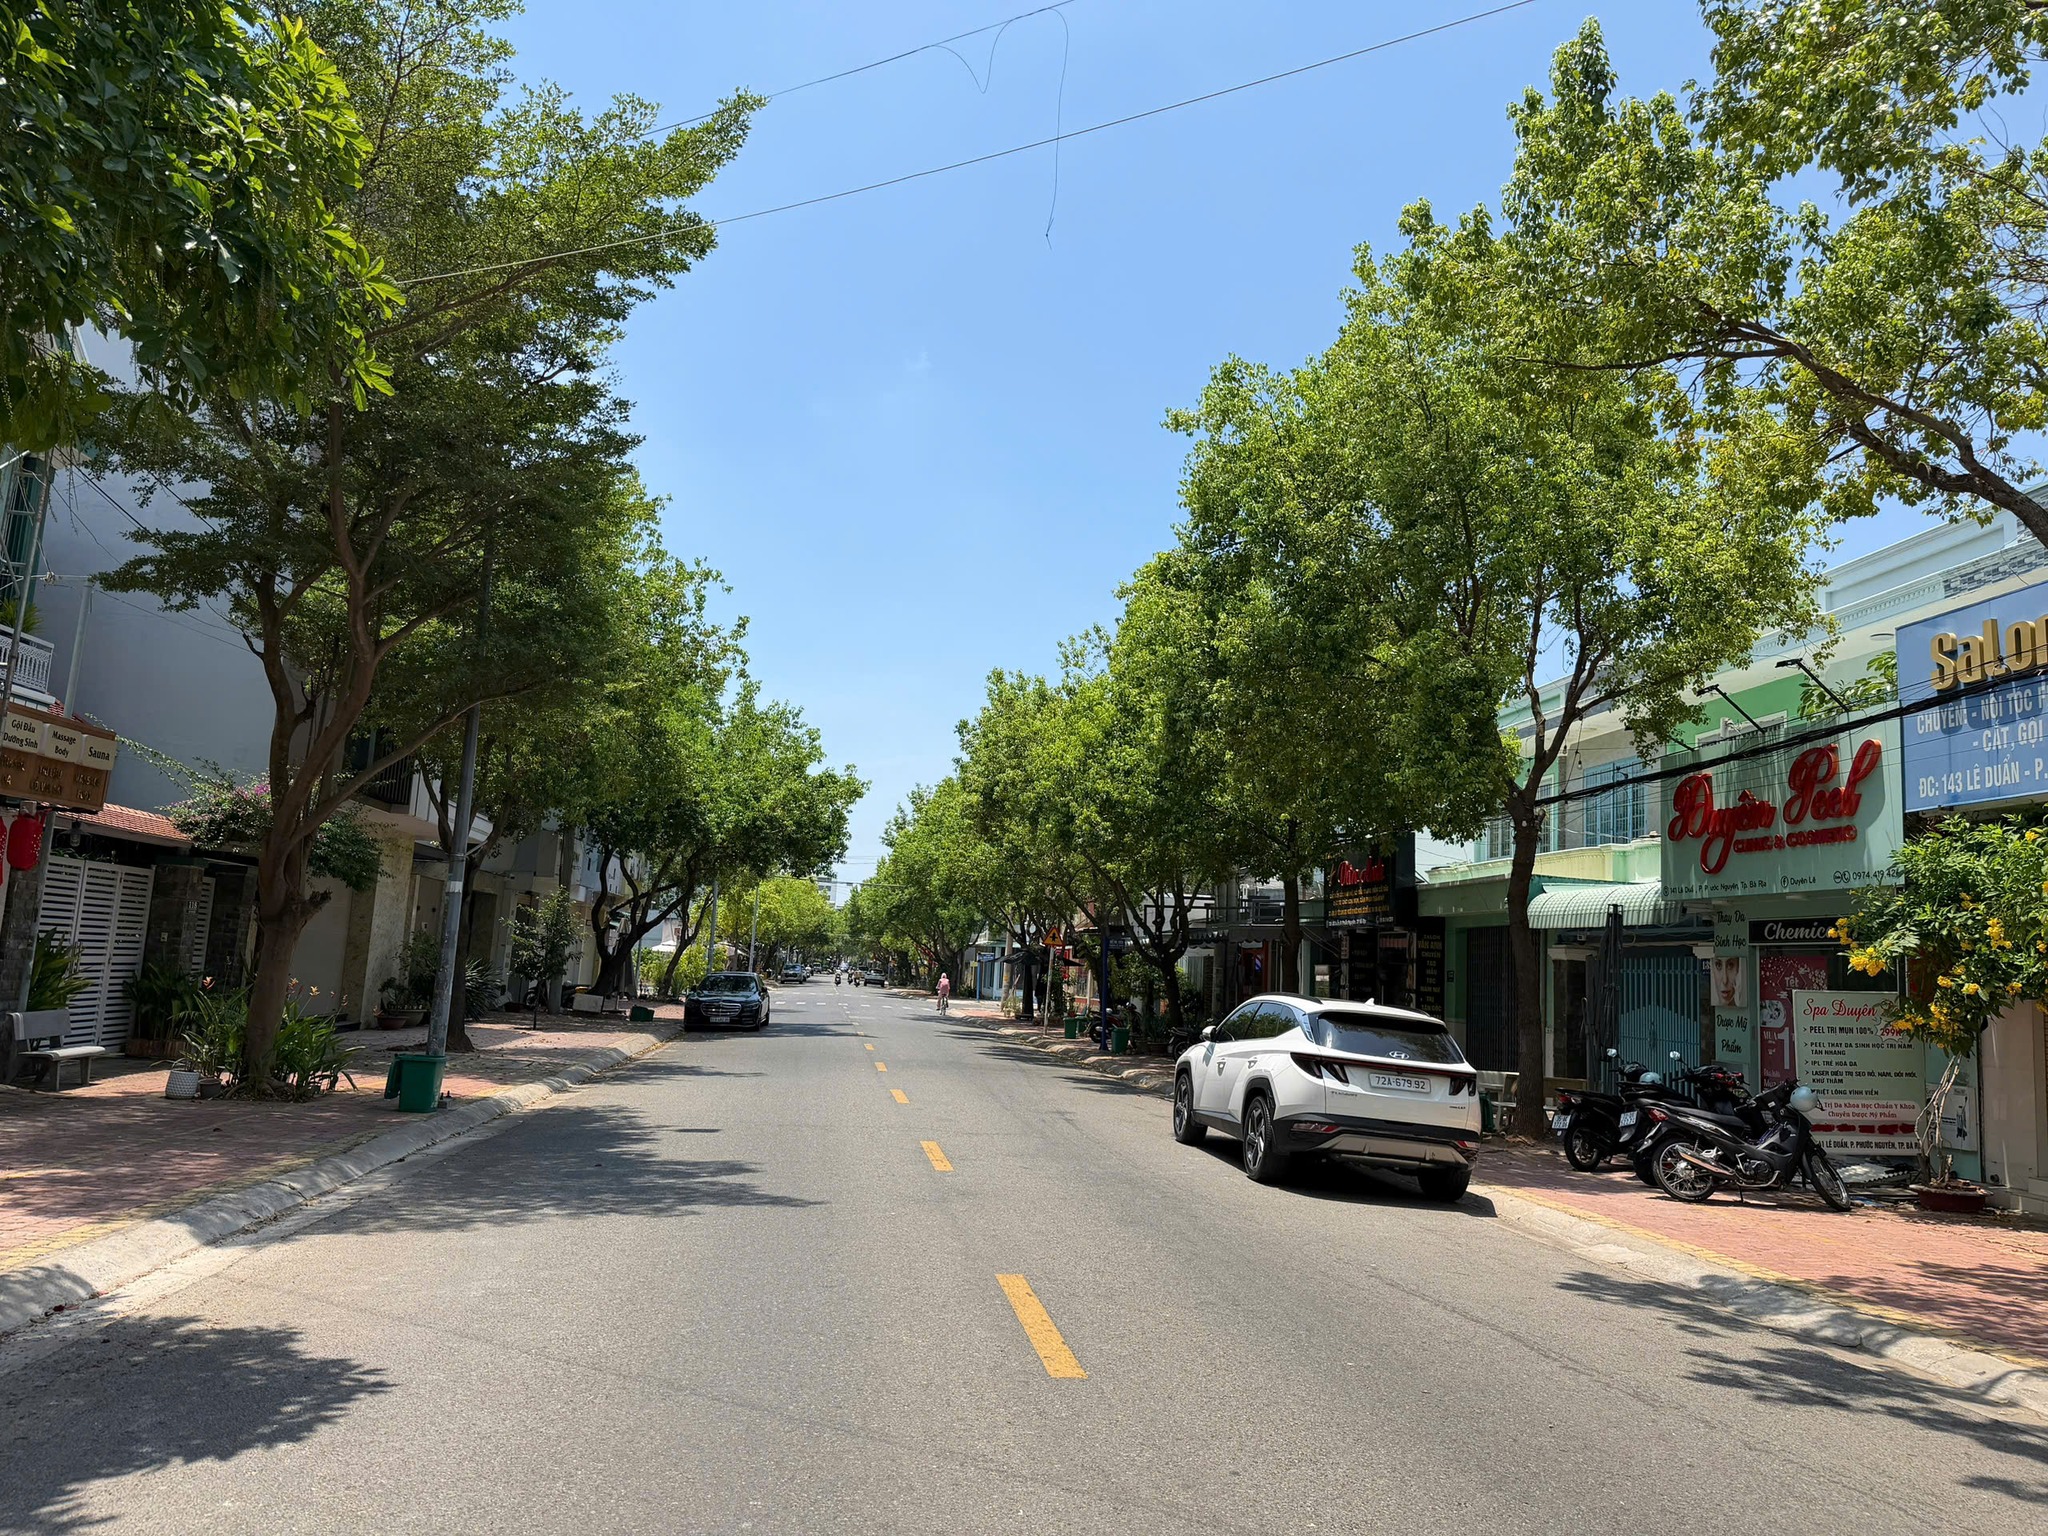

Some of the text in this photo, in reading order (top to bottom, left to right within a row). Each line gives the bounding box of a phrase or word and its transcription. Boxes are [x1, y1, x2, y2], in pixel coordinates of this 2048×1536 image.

[2006, 687, 2033, 715] TÓC
[11, 719, 23, 731] Gội
[3, 732, 38, 749] Dưỡng Sinh
[52, 730, 77, 746] Massage
[2018, 717, 2043, 749] GỘI
[54, 745, 70, 759] Body
[87, 746, 110, 761] Sauna
[1919, 777, 1939, 798] ĐC:
[1942, 772, 1963, 795] 143
[1967, 763, 1981, 791] LÊ
[1985, 753, 2020, 788] DUẨN
[1668, 738, 1882, 875] Duyên Peel
[1773, 834, 1785, 850] &
[1785, 824, 1858, 848] COSMETIC
[1749, 880, 1757, 888] Bà
[1790, 876, 1816, 887] Duyên Lê
[1716, 910, 1732, 926] Thay
[1714, 935, 1746, 948] Sinh Học
[1785, 971, 1799, 988] Tết
[1803, 998, 1877, 1022] Spa Duyên
[1716, 1014, 1748, 1032] Dược Mỹ
[1809, 1026, 1874, 1037] PEEL TRỊ MỤN 100%
[1721, 1039, 1743, 1053] Phẩm
[1375, 1075, 1426, 1090] 72A-679.92
[1873, 1101, 1894, 1109] Chuẩn
[1828, 1110, 1850, 1118] Chuyên
[1869, 1111, 1878, 1119] Mỹ
[1879, 1109, 1897, 1118] Phẩm
[1825, 1139, 1832, 1148] LÊ
[1856, 1139, 1874, 1149] PHƯỚC
[1874, 1140, 1897, 1150] NGUYÊN,
[1898, 1141, 1906, 1149] TP.
[1907, 1140, 1914, 1150] BÀ
